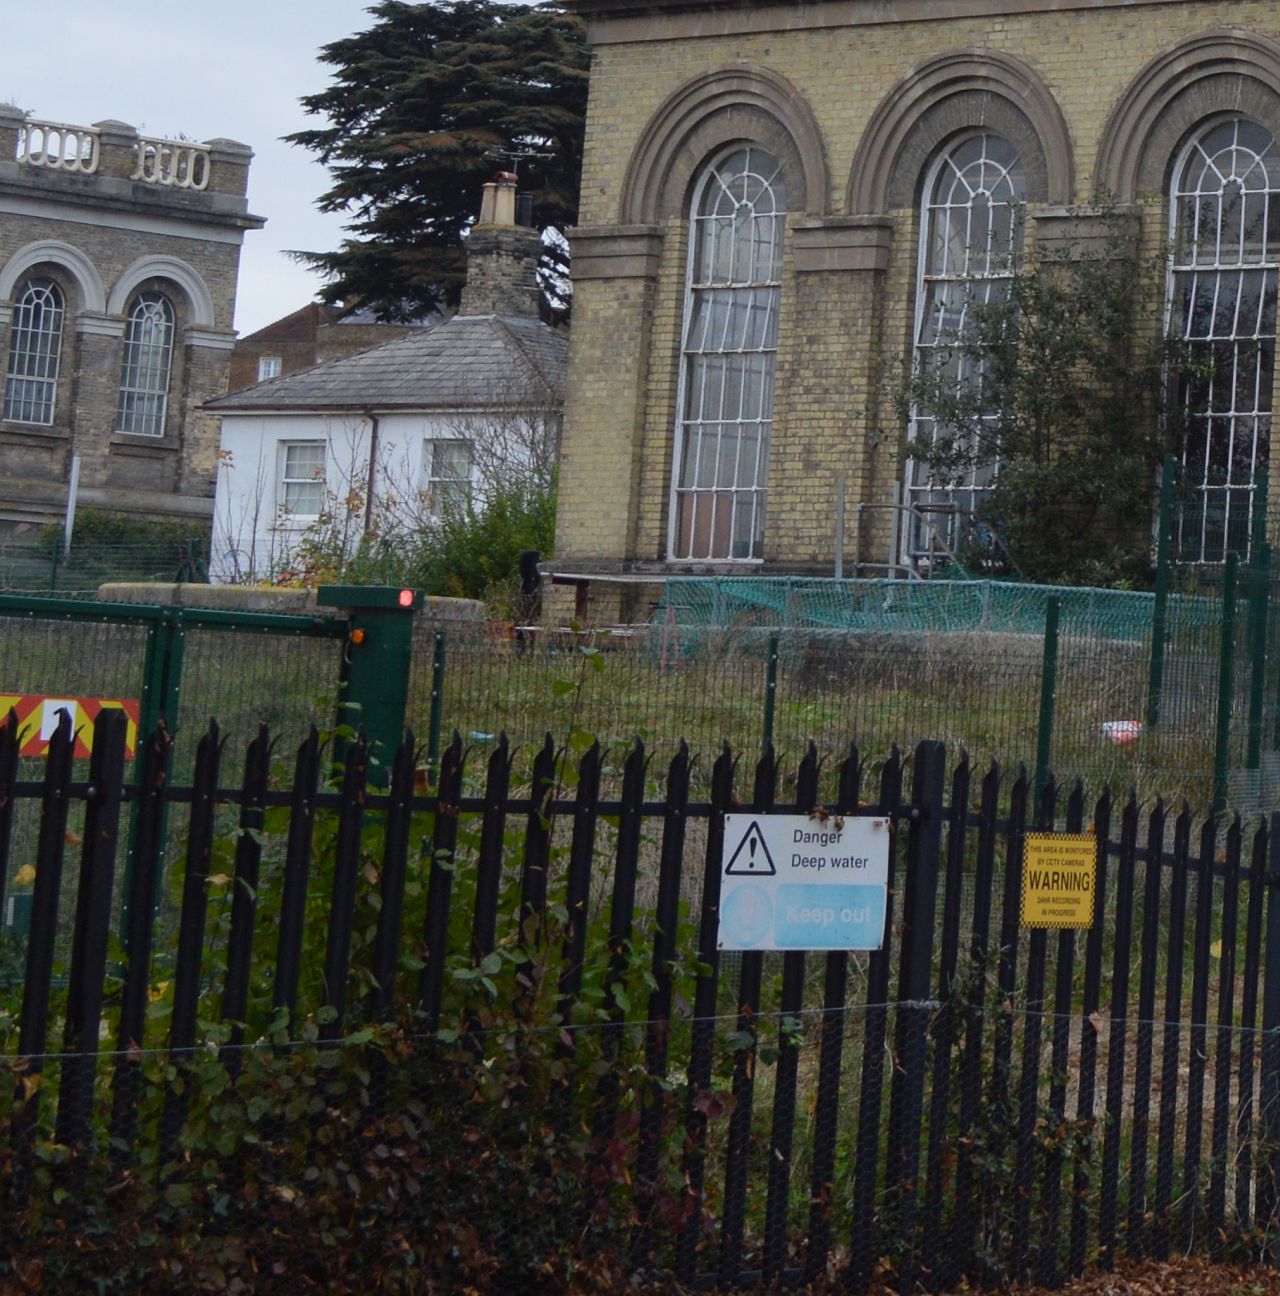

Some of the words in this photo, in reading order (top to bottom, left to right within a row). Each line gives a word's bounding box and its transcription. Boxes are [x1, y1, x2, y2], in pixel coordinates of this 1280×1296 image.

[793, 829, 842, 847] Danger
[791, 854, 826, 871] Deep
[831, 855, 868, 869] water
[1029, 870, 1090, 891] WARNING
[786, 906, 835, 926] Keep
[840, 907, 871, 922] out
